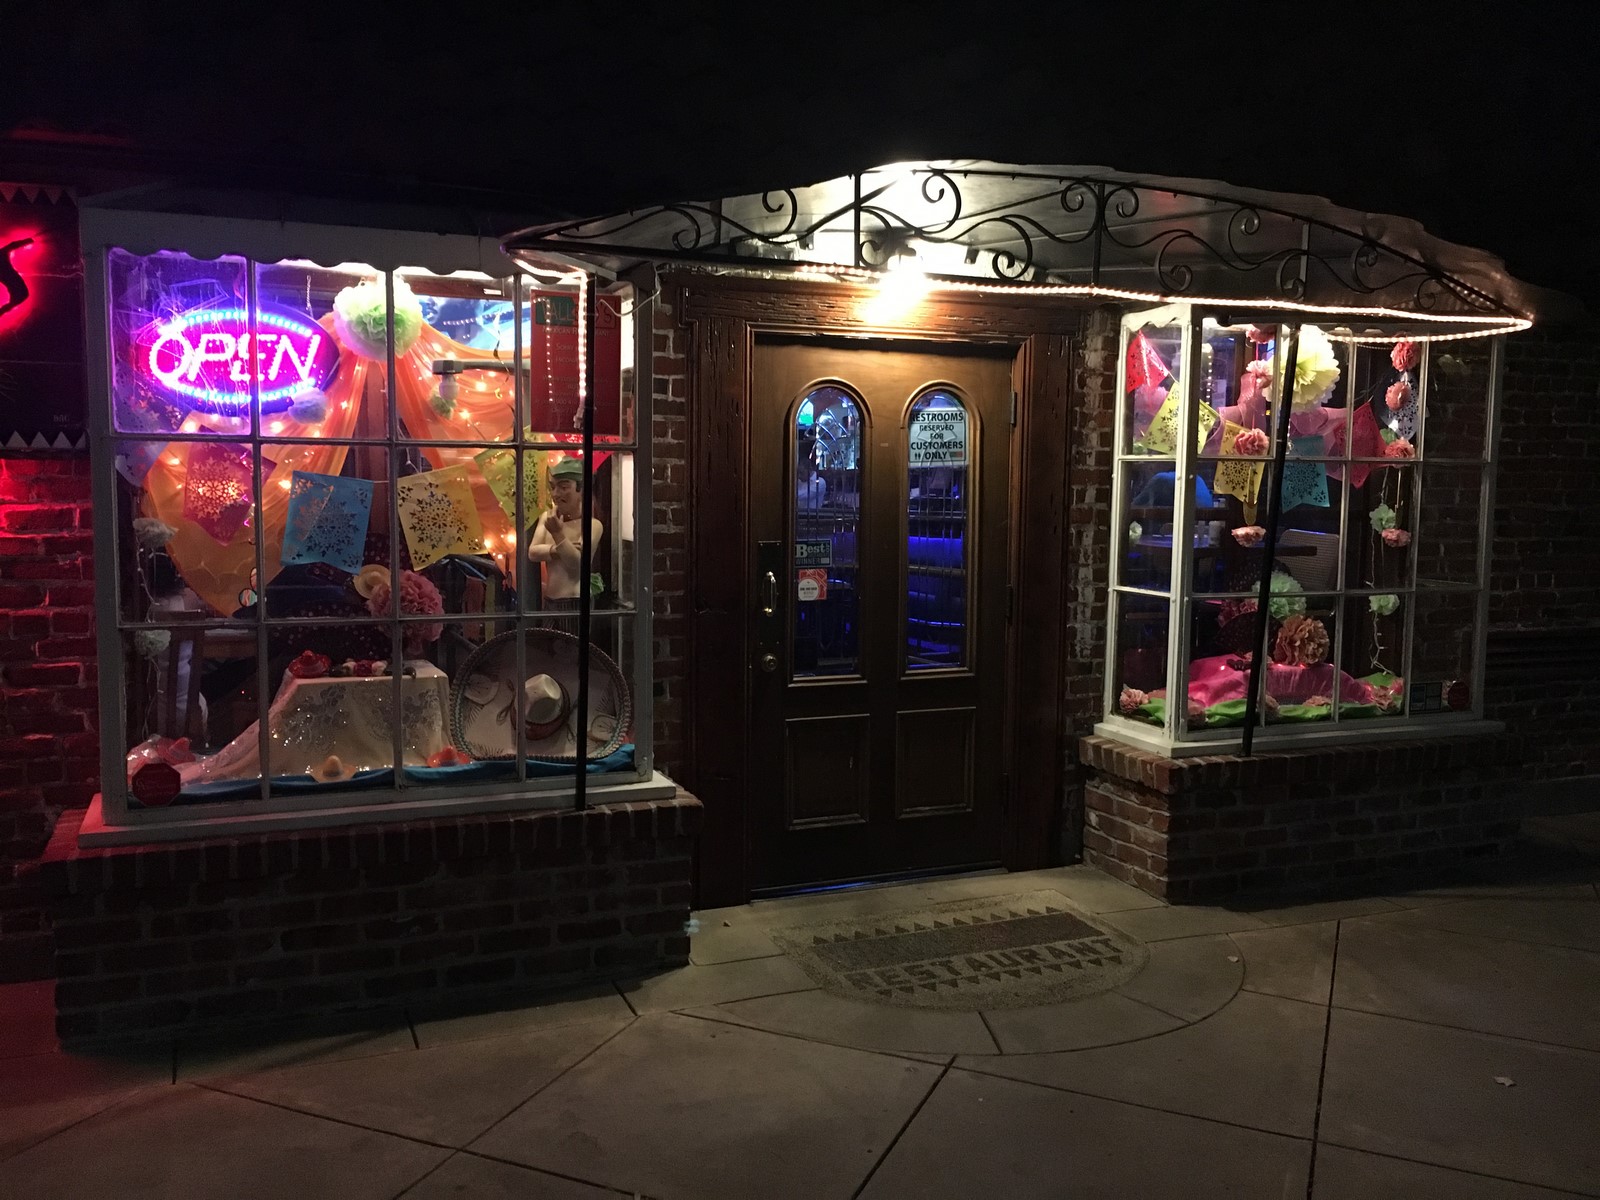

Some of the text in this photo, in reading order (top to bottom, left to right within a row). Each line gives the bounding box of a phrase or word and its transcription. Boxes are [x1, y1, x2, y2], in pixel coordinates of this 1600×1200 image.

[149, 332, 321, 383] OPEN
[911, 441, 964, 450] CUSTOMERS
[924, 451, 948, 460] ONLY
[795, 543, 826, 558] Best
[844, 937, 1125, 991] RESTAURANT
